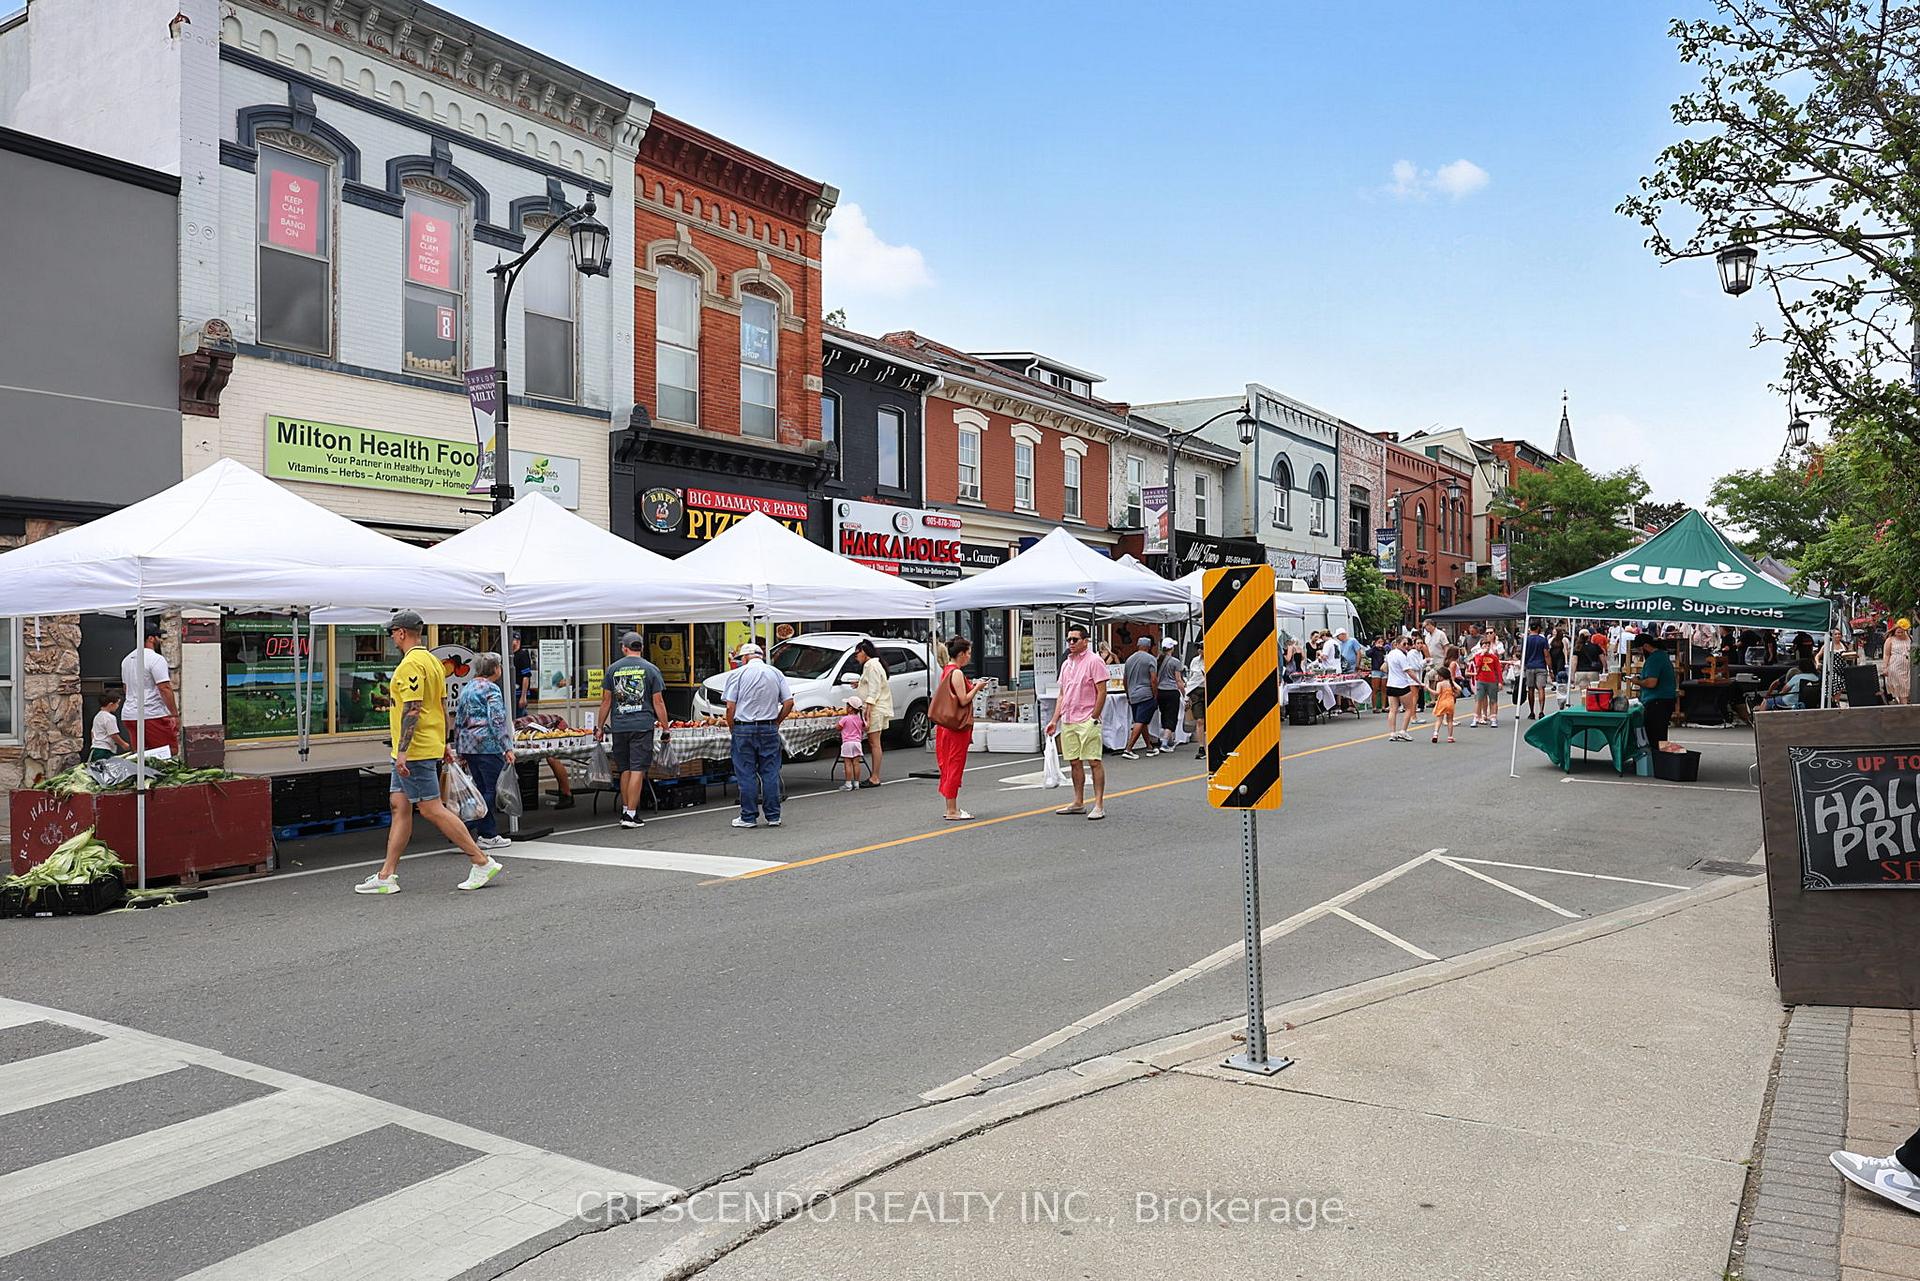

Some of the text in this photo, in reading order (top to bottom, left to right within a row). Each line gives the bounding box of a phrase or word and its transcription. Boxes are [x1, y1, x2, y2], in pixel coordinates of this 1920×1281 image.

[282, 203, 304, 215] CALM
[284, 195, 303, 206] KEEP
[285, 227, 299, 238] ON
[422, 234, 438, 243] KEEP
[442, 316, 451, 338] 8
[467, 374, 495, 385] EXPLOR
[470, 390, 495, 402] MILTO
[277, 421, 480, 467] Milton Health Foo
[326, 453, 461, 478] Your Partner in Healthy Lifestyle
[287, 461, 470, 490] Vitamins Herbs Aromatherapy Homeo
[689, 491, 711, 506] BIG
[715, 494, 760, 511] MAMA'S
[762, 501, 771, 513] &
[773, 502, 807, 518] PAPA'S
[840, 529, 960, 563] HAKKA HOUSE
[973, 549, 1000, 566] Country
[1614, 599, 1676, 614] Simple.
[1856, 755, 1920, 772] UP TO
[30, 799, 62, 821] HAIST
[1814, 773, 1920, 834] HAL
[1833, 813, 1920, 868] PRI
